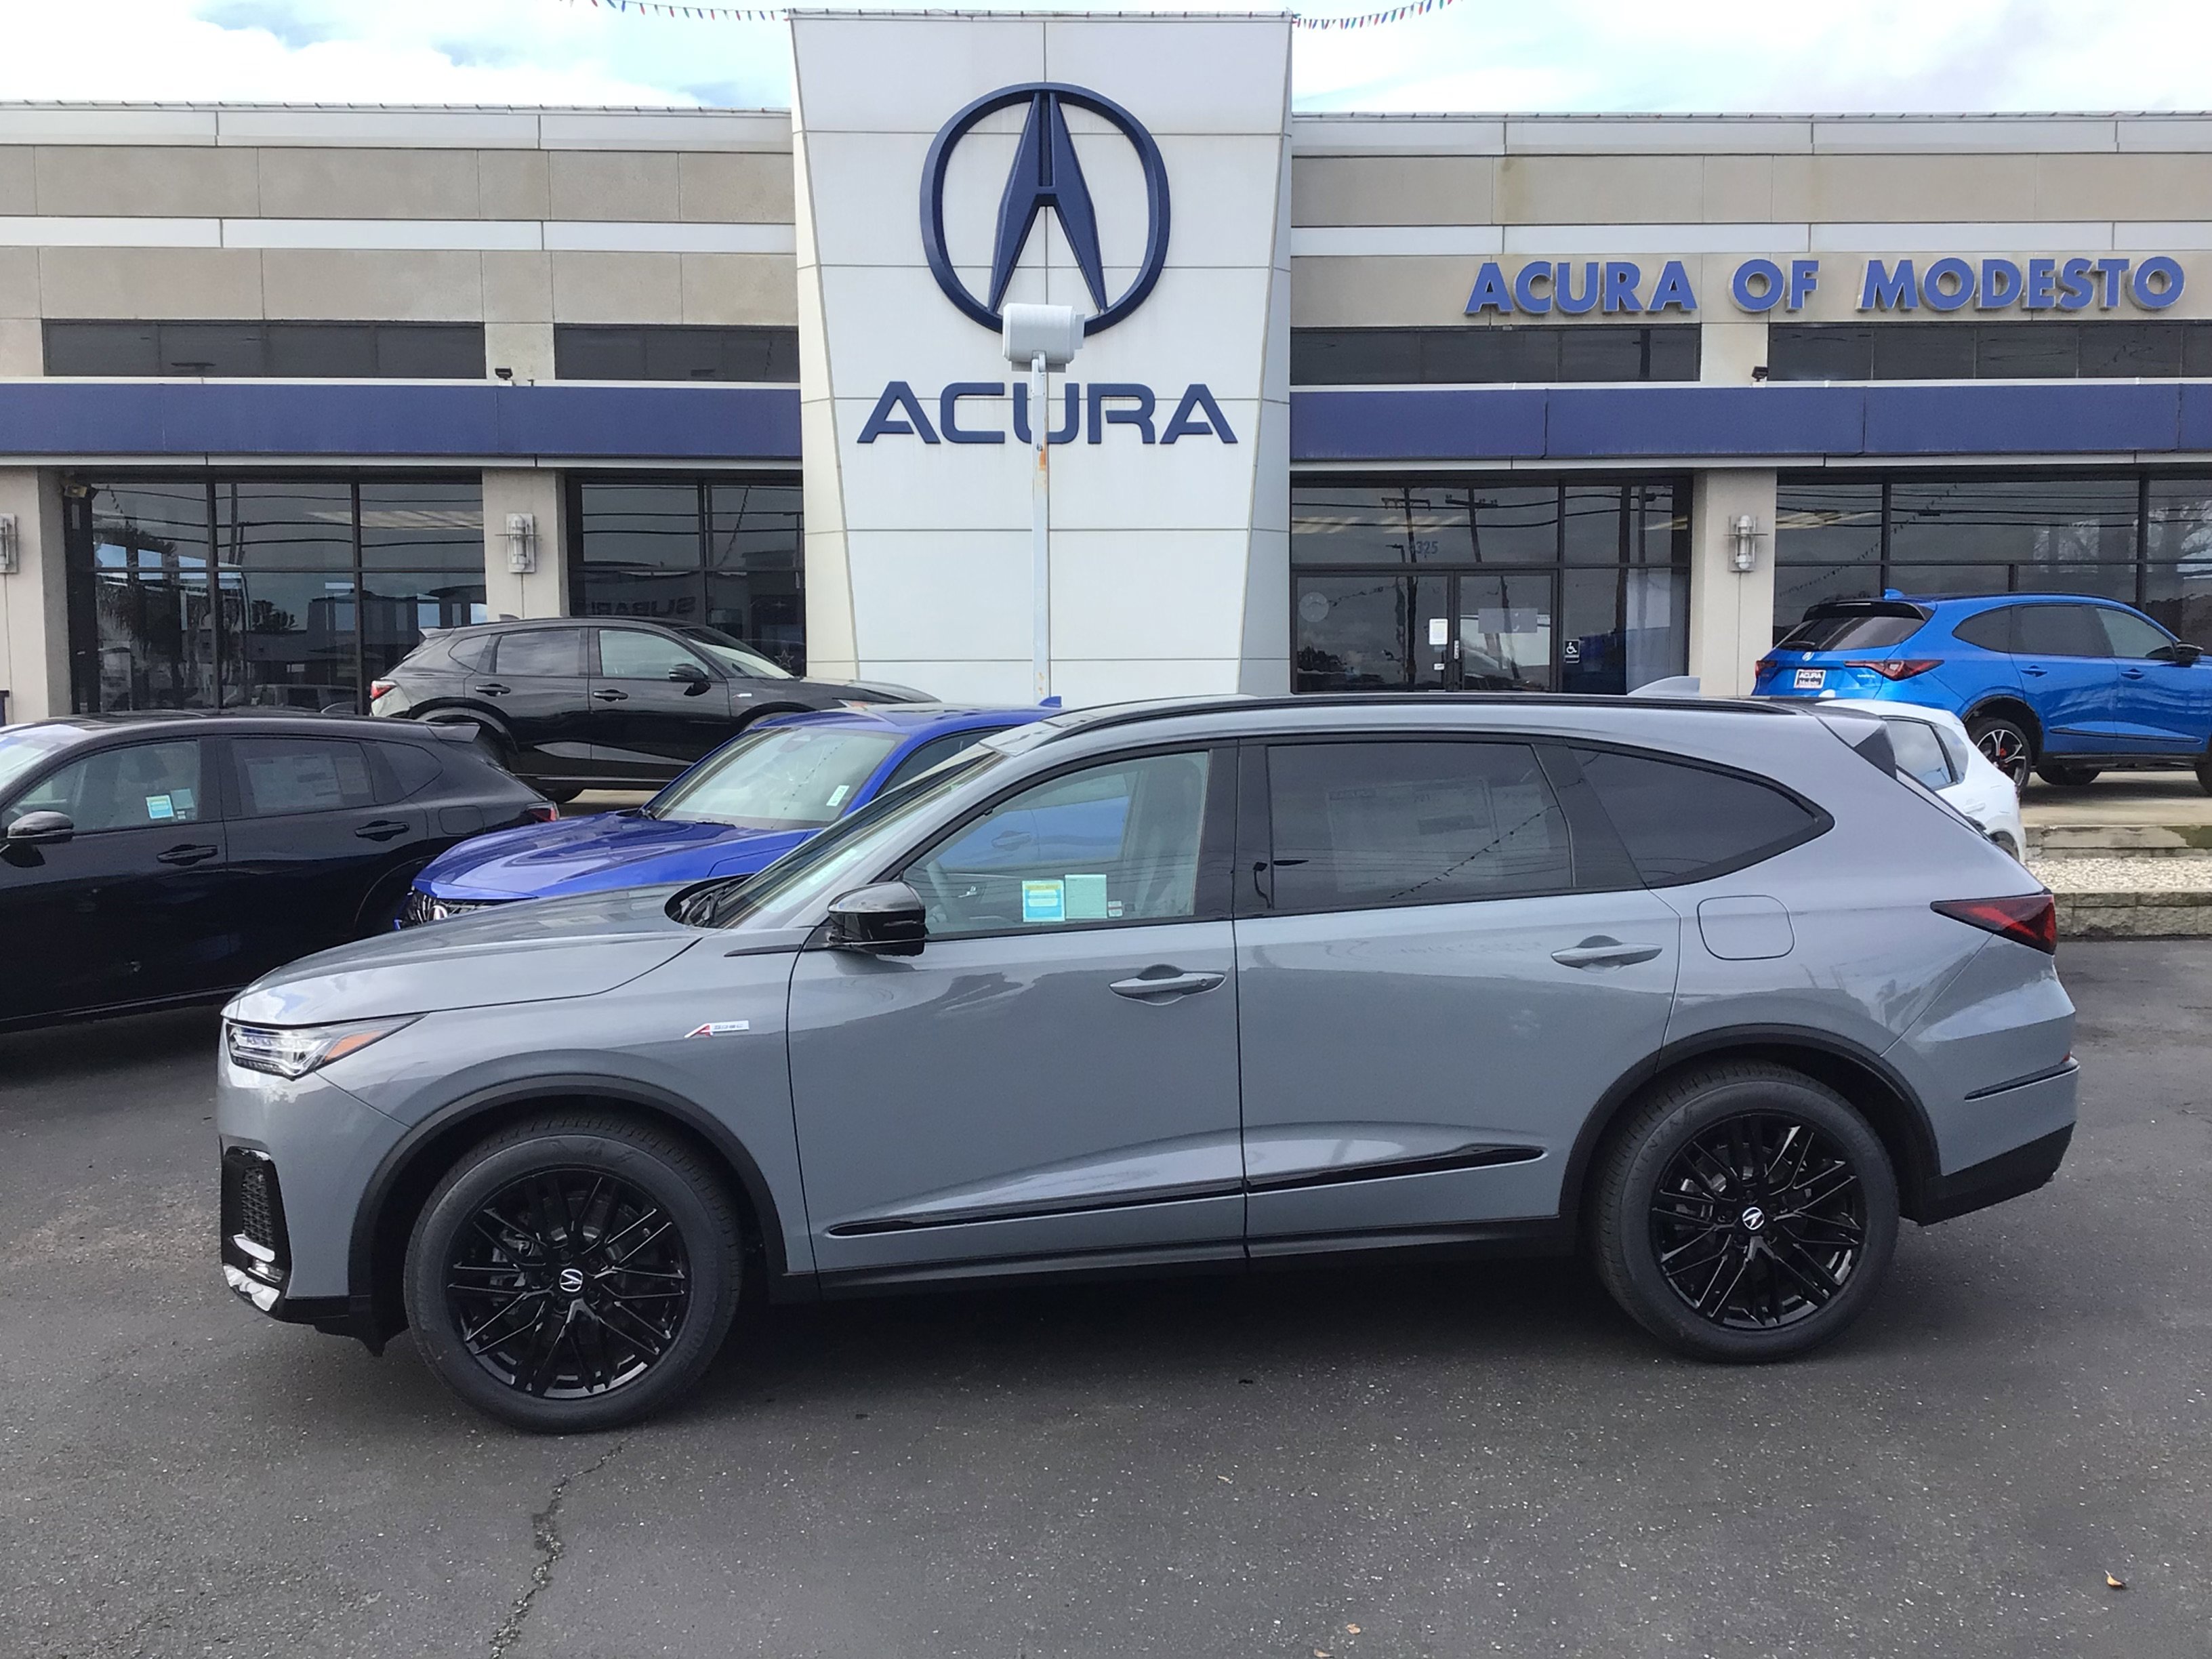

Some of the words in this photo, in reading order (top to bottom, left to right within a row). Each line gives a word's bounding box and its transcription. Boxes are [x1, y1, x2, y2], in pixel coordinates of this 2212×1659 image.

[1464, 260, 1698, 315] ACURA
[1731, 258, 1819, 312] OF
[1856, 255, 2186, 311] MODESTO
[857, 381, 1238, 445] ACURA
